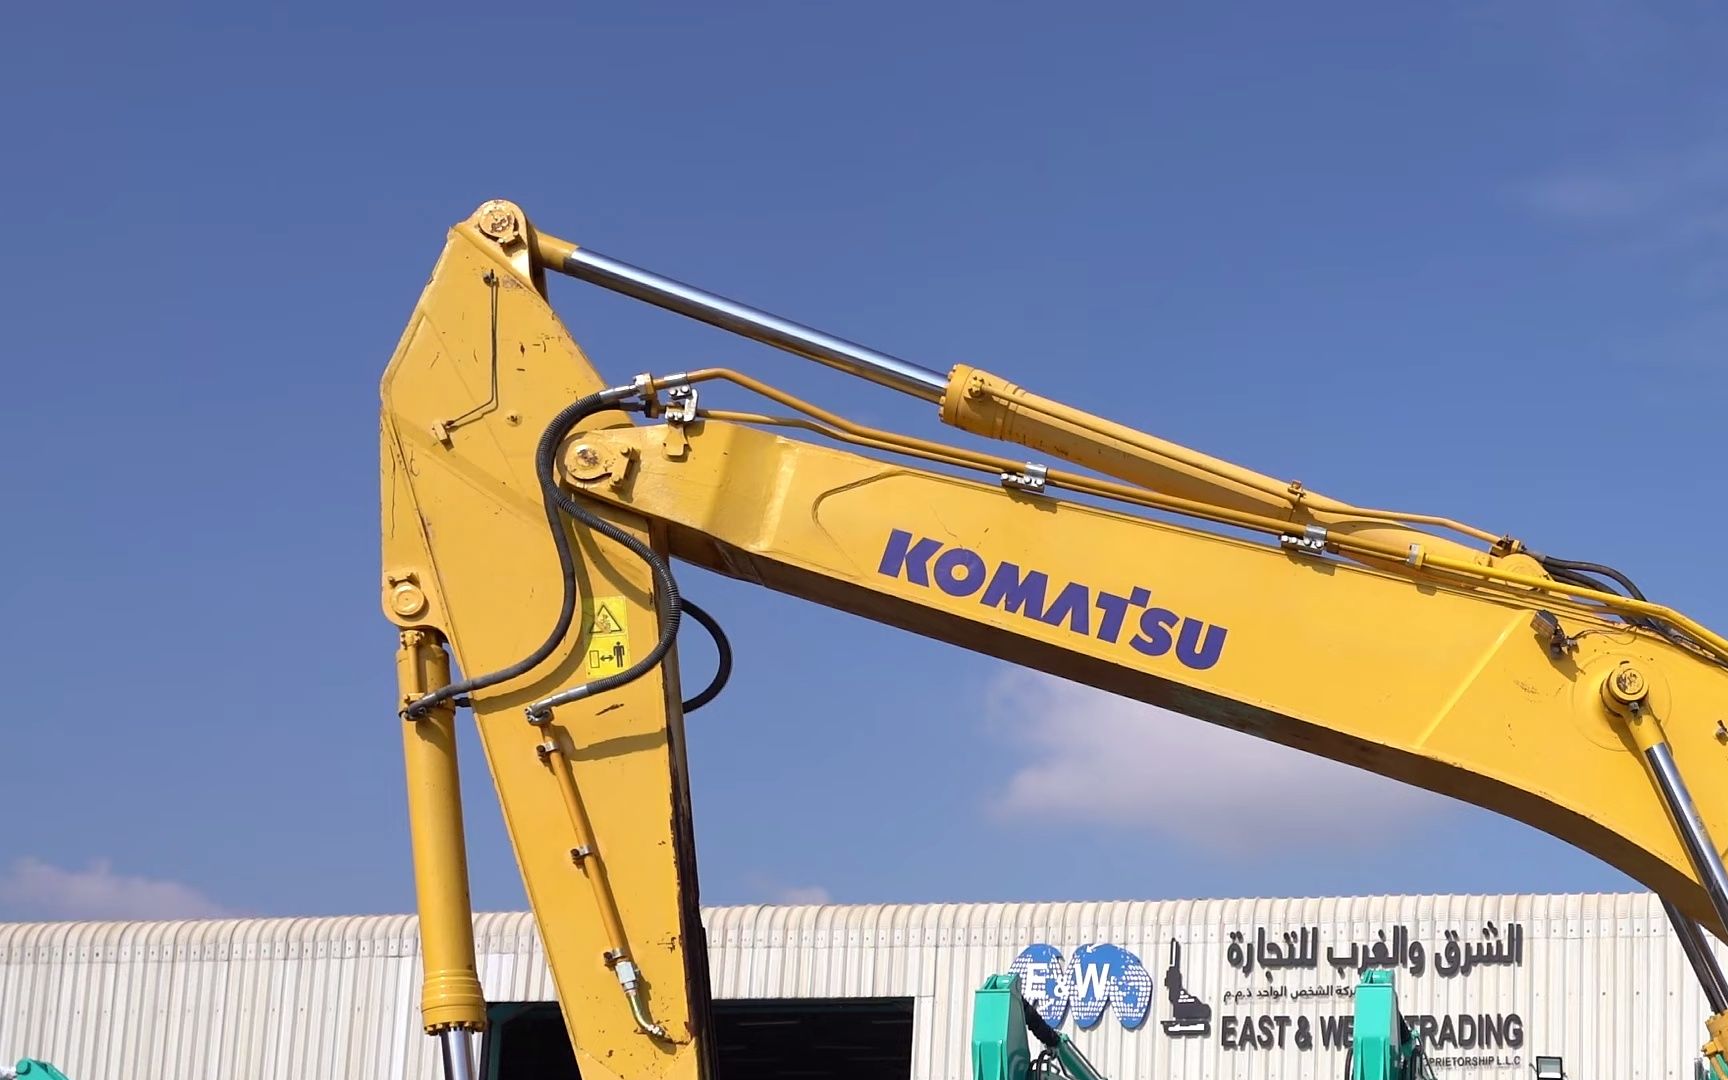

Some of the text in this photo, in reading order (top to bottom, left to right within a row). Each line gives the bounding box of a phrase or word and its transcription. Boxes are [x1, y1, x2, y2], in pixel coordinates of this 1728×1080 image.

[878, 528, 1228, 670] KOMATSU
[1227, 920, 1523, 983] الشرق والغرب للتجارة
[1256, 985, 1288, 1000] الواحد
[1290, 985, 1334, 1001] الشخص
[1221, 1015, 1290, 1050] EAST
[1294, 1014, 1314, 1050] &
[1320, 1015, 1355, 1051] WE
